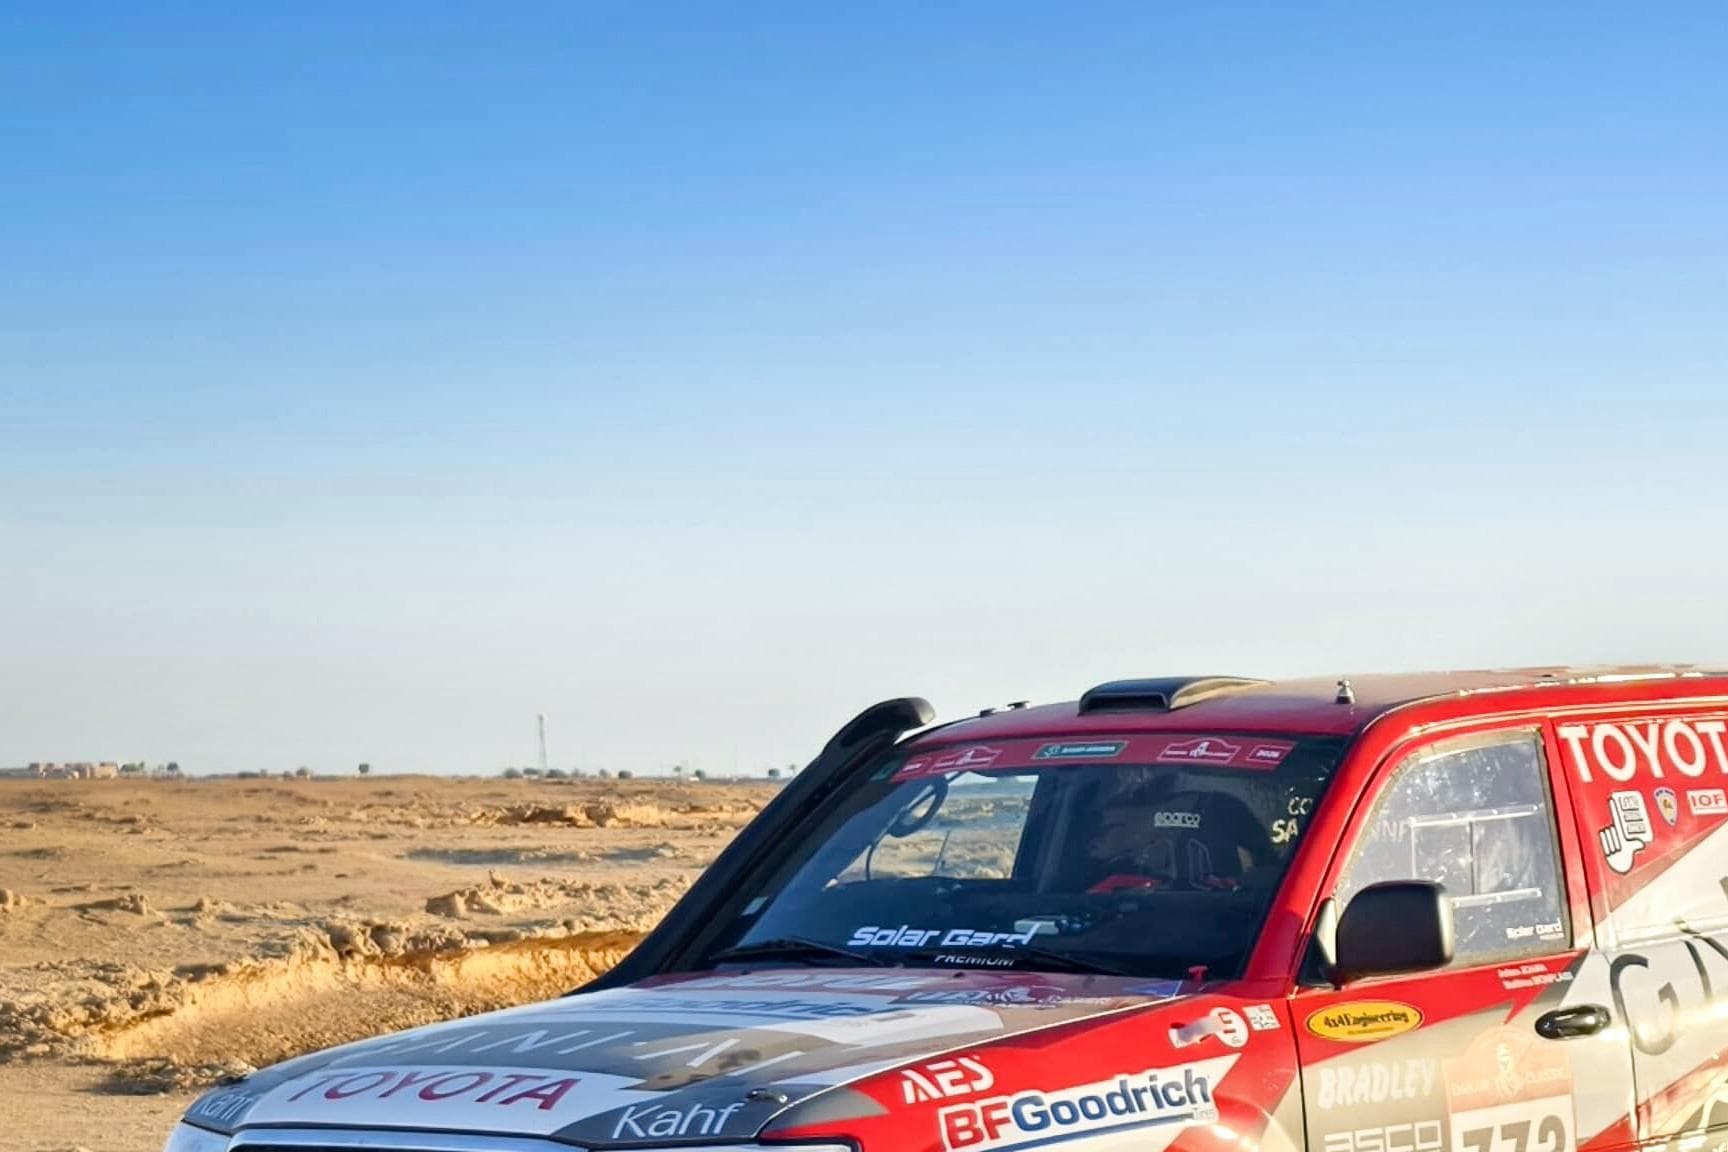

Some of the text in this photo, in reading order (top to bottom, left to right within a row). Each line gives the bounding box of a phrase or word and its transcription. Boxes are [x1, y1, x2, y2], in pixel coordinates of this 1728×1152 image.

[847, 924, 940, 946] Solar
[287, 1070, 582, 1112] TOYOTA
[1318, 1057, 1435, 1110] BRADLEY
[611, 1100, 745, 1140] Kahf
[946, 1068, 1211, 1150] BFGoodrich
